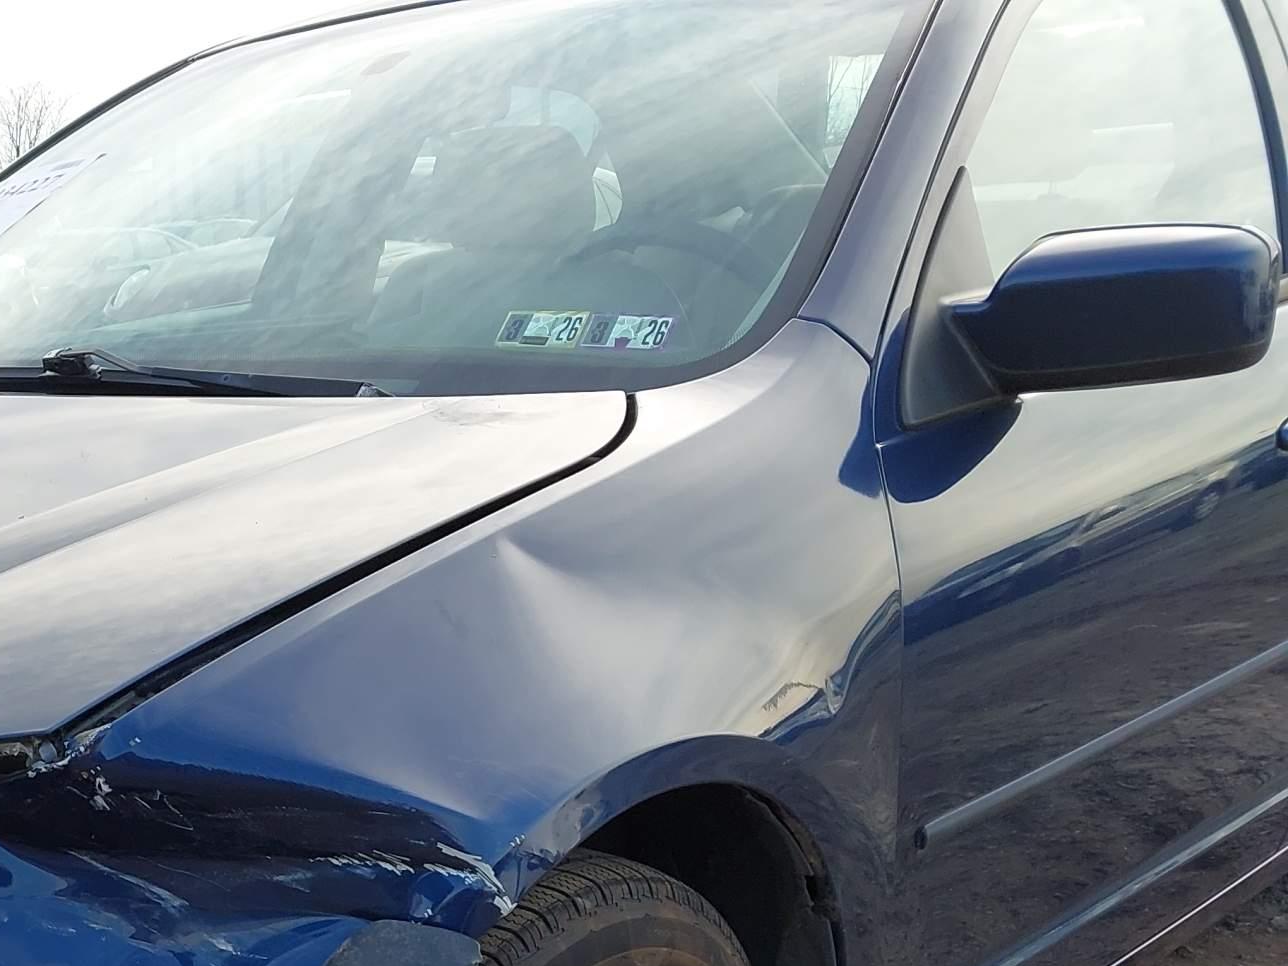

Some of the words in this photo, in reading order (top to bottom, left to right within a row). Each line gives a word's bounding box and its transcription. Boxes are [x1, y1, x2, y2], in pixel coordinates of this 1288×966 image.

[556, 316, 584, 342] 26
[589, 321, 610, 344] 3
[641, 319, 670, 346] 26
